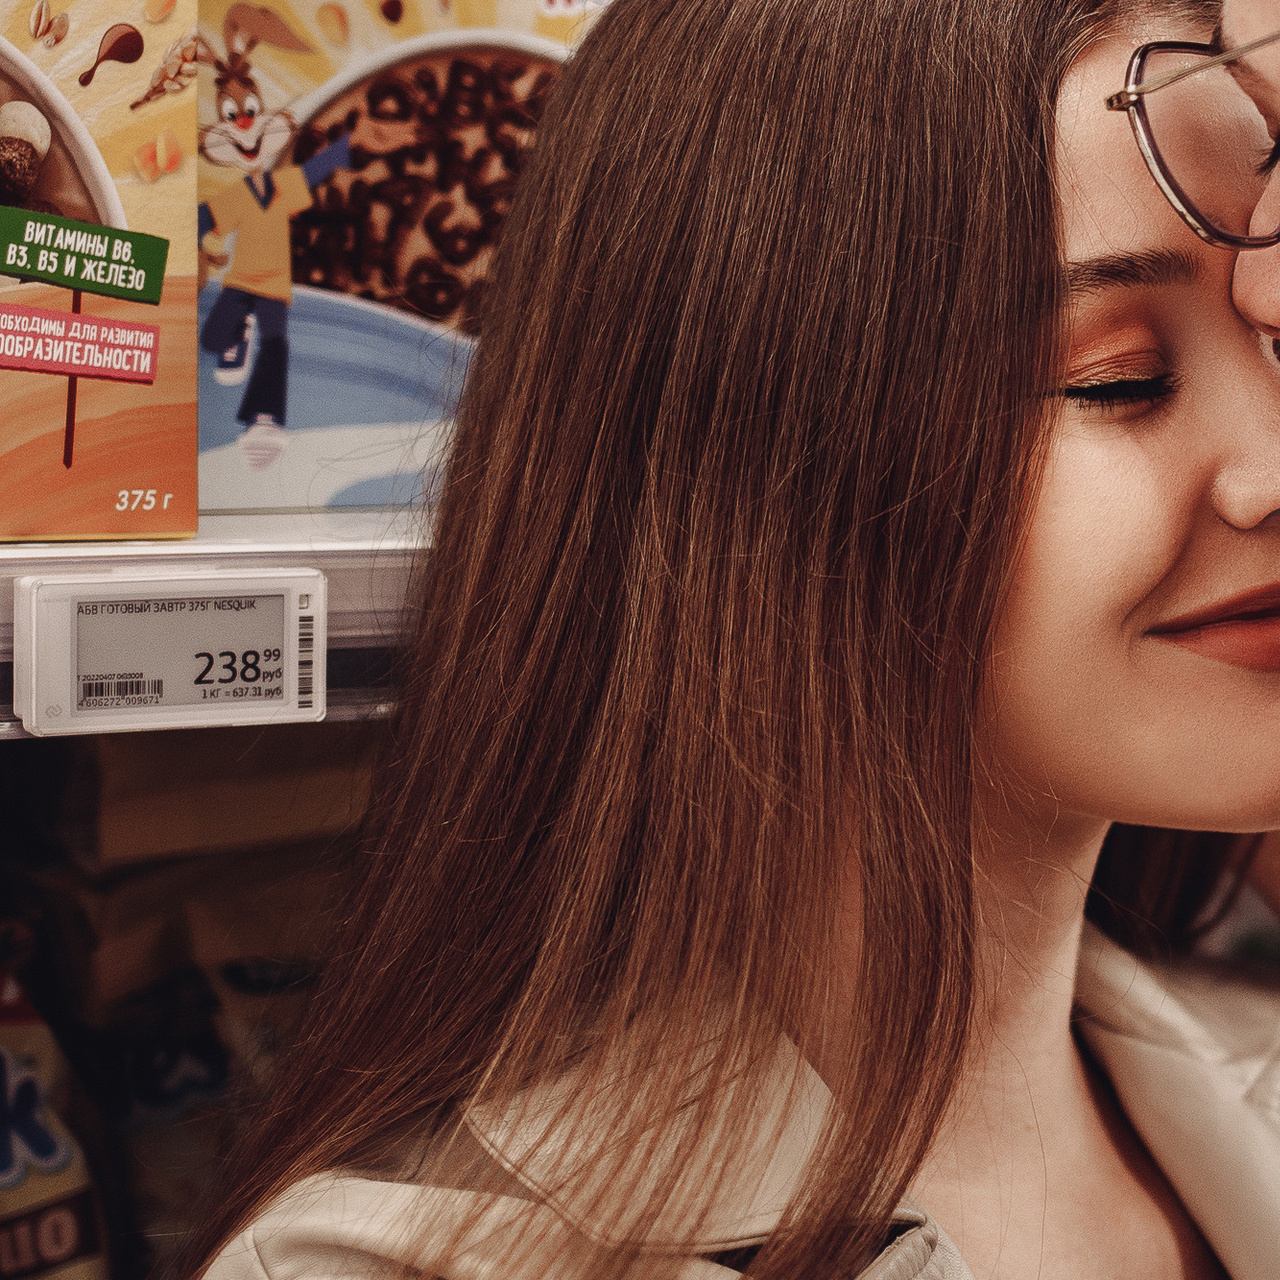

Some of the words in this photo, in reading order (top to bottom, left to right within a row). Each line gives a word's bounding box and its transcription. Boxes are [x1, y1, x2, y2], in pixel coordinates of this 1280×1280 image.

[24, 220, 109, 258] ВИТАМИНЫ
[37, 250, 59, 273] В5
[64, 254, 77, 277] И
[80, 258, 145, 291] ЖЕЛЕЗО
[69, 322, 97, 341] ДЛЯ
[101, 326, 154, 349] РАЗВИТИЯ
[115, 489, 157, 511] 375
[163, 493, 174, 510] г
[77, 605, 98, 615] АБВ
[100, 600, 150, 615] ГОТОВЫЙ
[153, 601, 186, 613] ЗАВТР
[189, 600, 211, 612] 375Г
[214, 599, 256, 612] NESQUIK
[194, 650, 261, 685] 238
[263, 648, 280, 662] 99
[262, 667, 282, 682] руб
[78, 700, 84, 708] 4
[86, 697, 121, 708] 606272
[125, 695, 159, 706] 009671
[202, 689, 208, 699] 1
[210, 688, 221, 698] КГ
[232, 686, 262, 698] 637.31
[264, 686, 282, 698] руб
